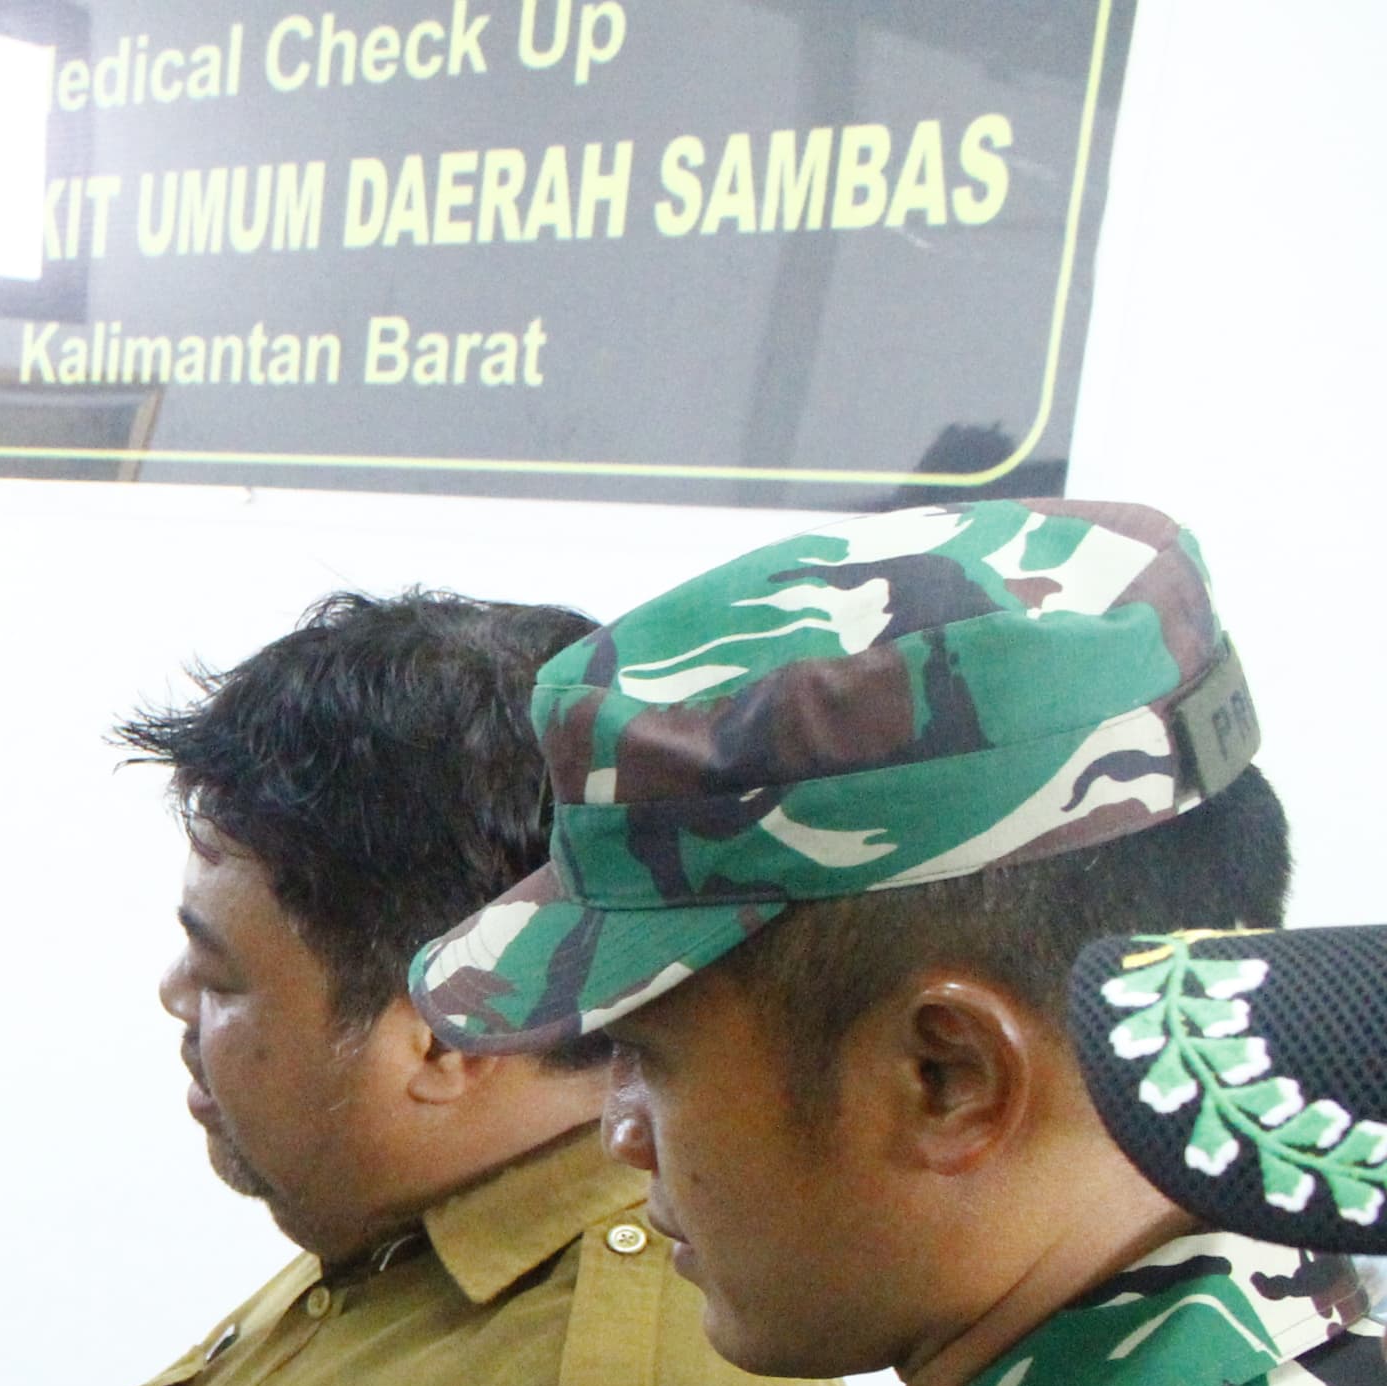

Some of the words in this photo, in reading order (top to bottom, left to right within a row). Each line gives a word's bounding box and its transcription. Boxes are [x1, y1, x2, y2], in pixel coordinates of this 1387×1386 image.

[47, 22, 244, 113] edical
[265, 0, 491, 93] Check
[517, 0, 628, 85] Up
[42, 175, 120, 261] KIT
[137, 161, 326, 256] UMUM
[342, 140, 634, 249] DAERAH
[654, 113, 1014, 236] SAMBAS
[19, 321, 341, 386] Kalimantan
[364, 315, 547, 386] Barat
